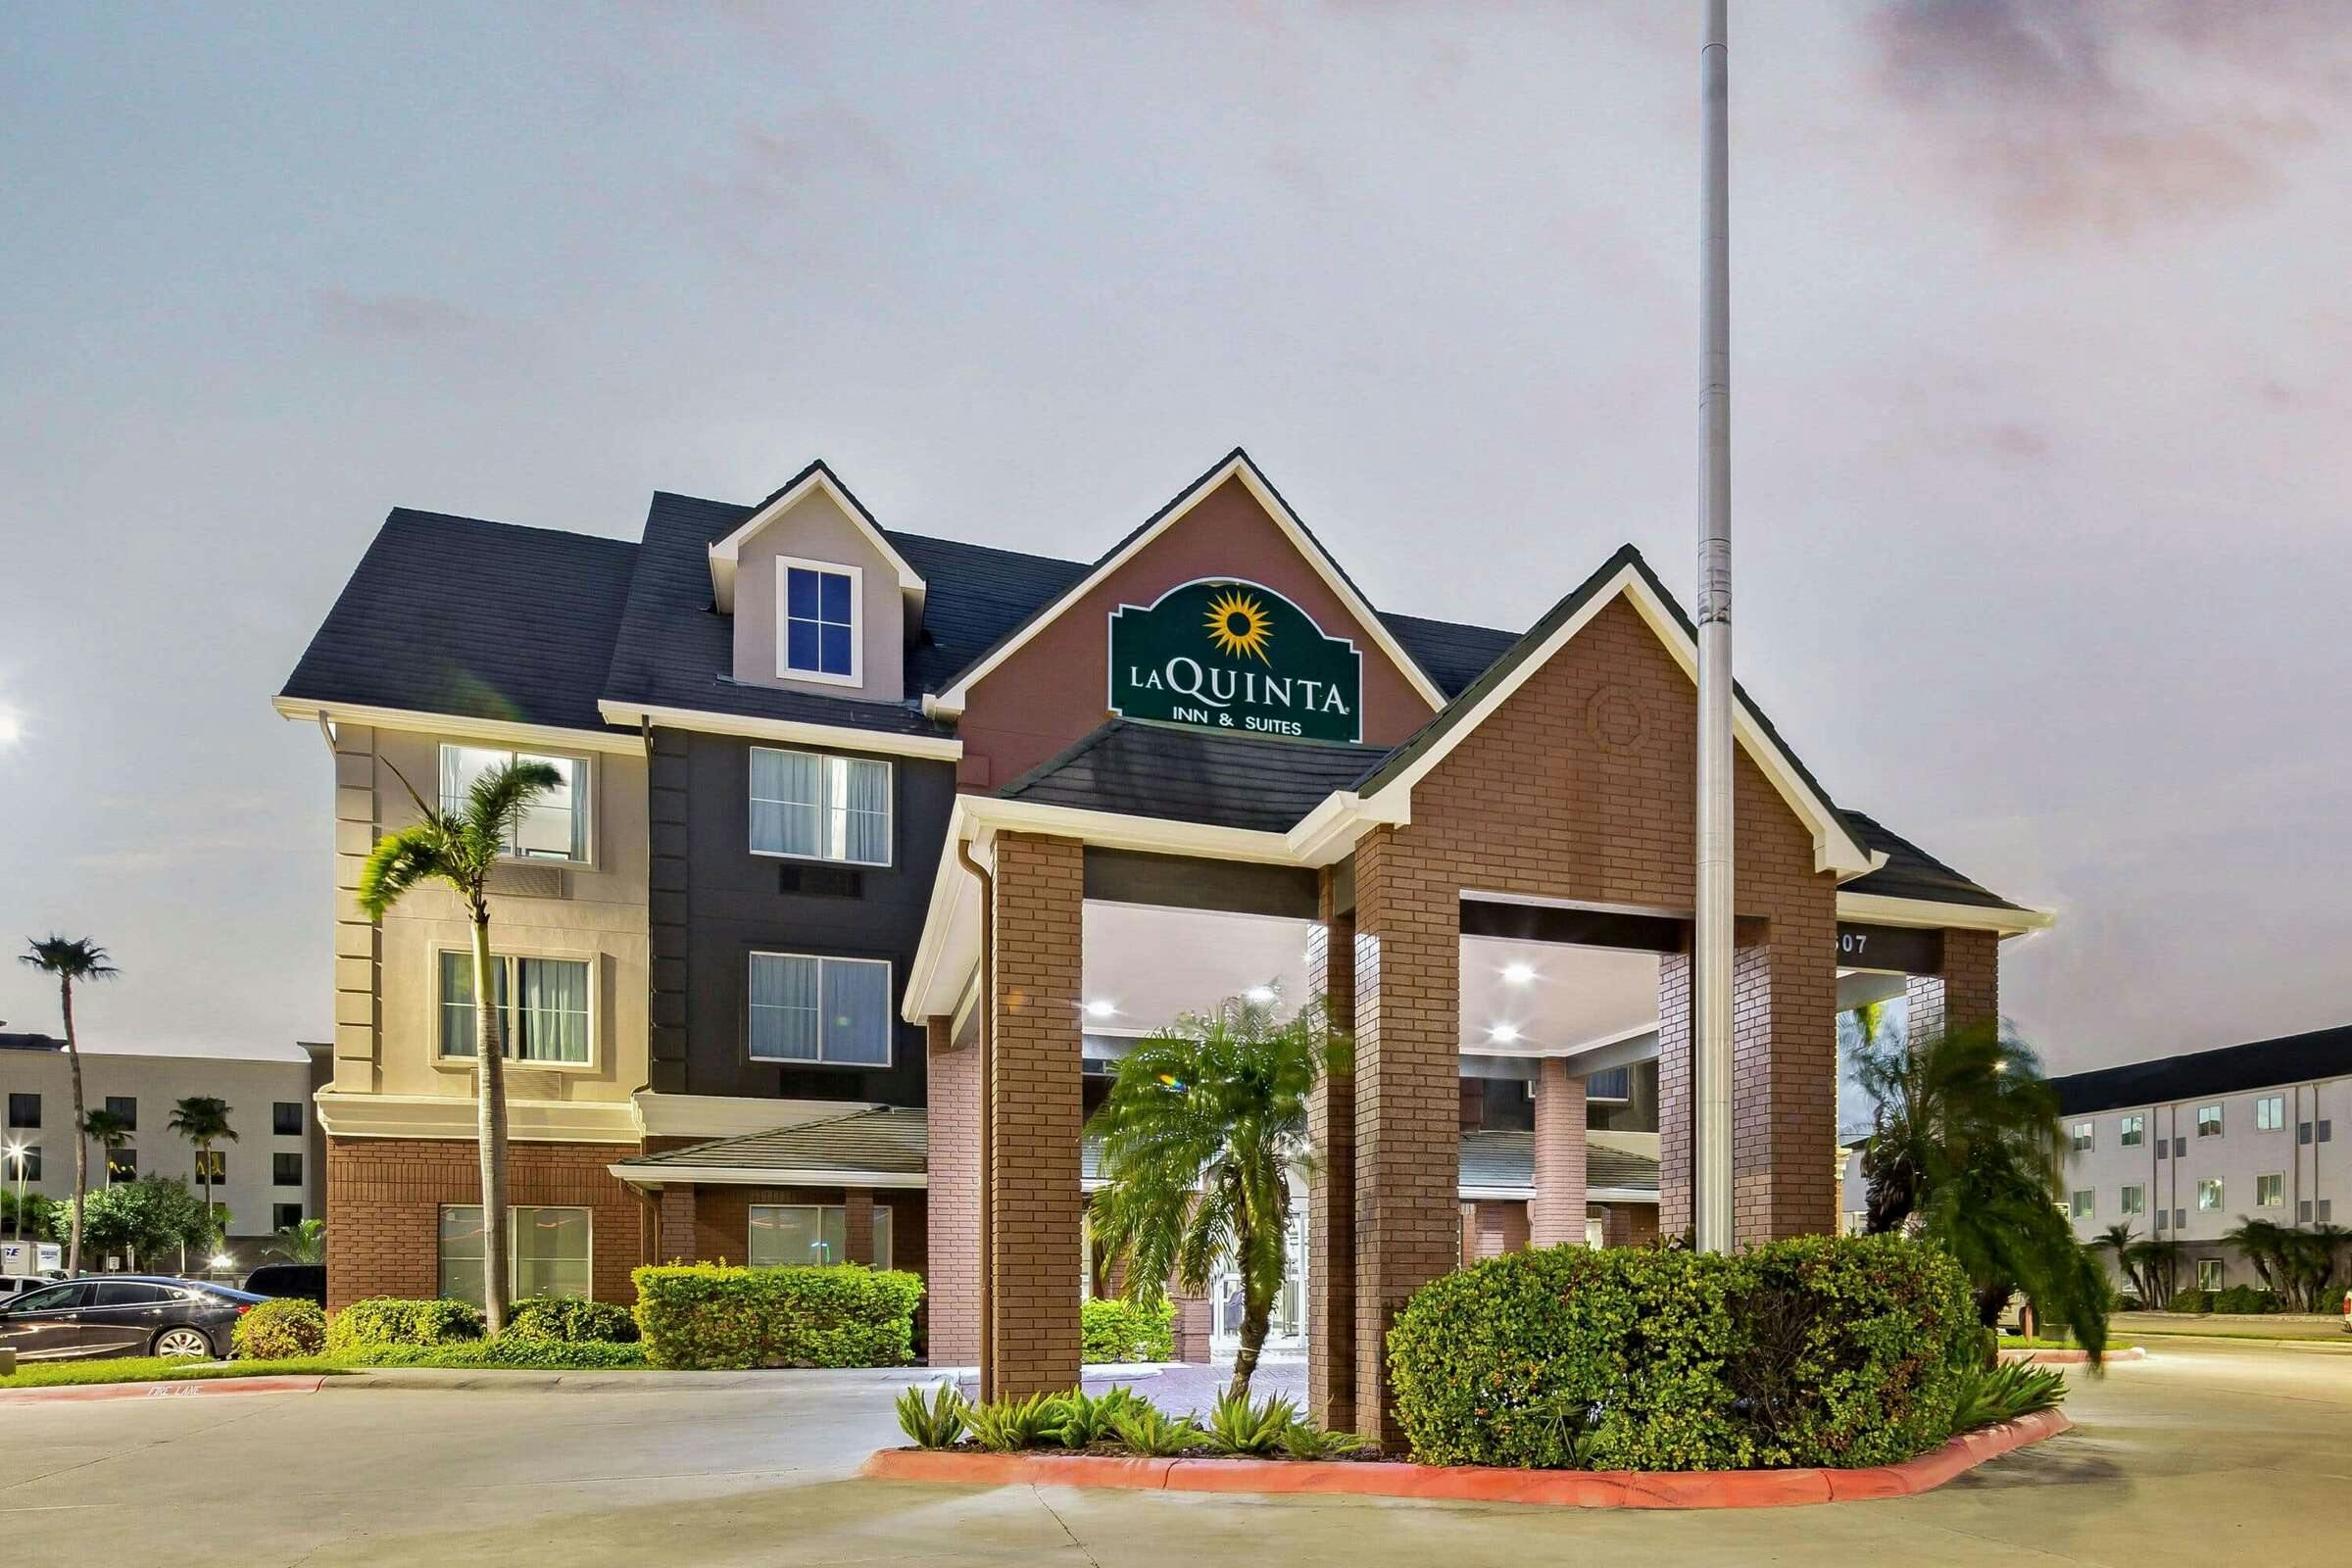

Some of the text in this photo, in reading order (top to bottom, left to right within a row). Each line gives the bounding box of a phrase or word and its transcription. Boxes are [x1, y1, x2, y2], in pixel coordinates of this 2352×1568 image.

[1131, 657, 1348, 715] LA QUINTA
[1173, 707, 1301, 735] INN & SUITES
[1835, 934, 1867, 954] 07
[147, 1386, 204, 1396] FIRE LANE
